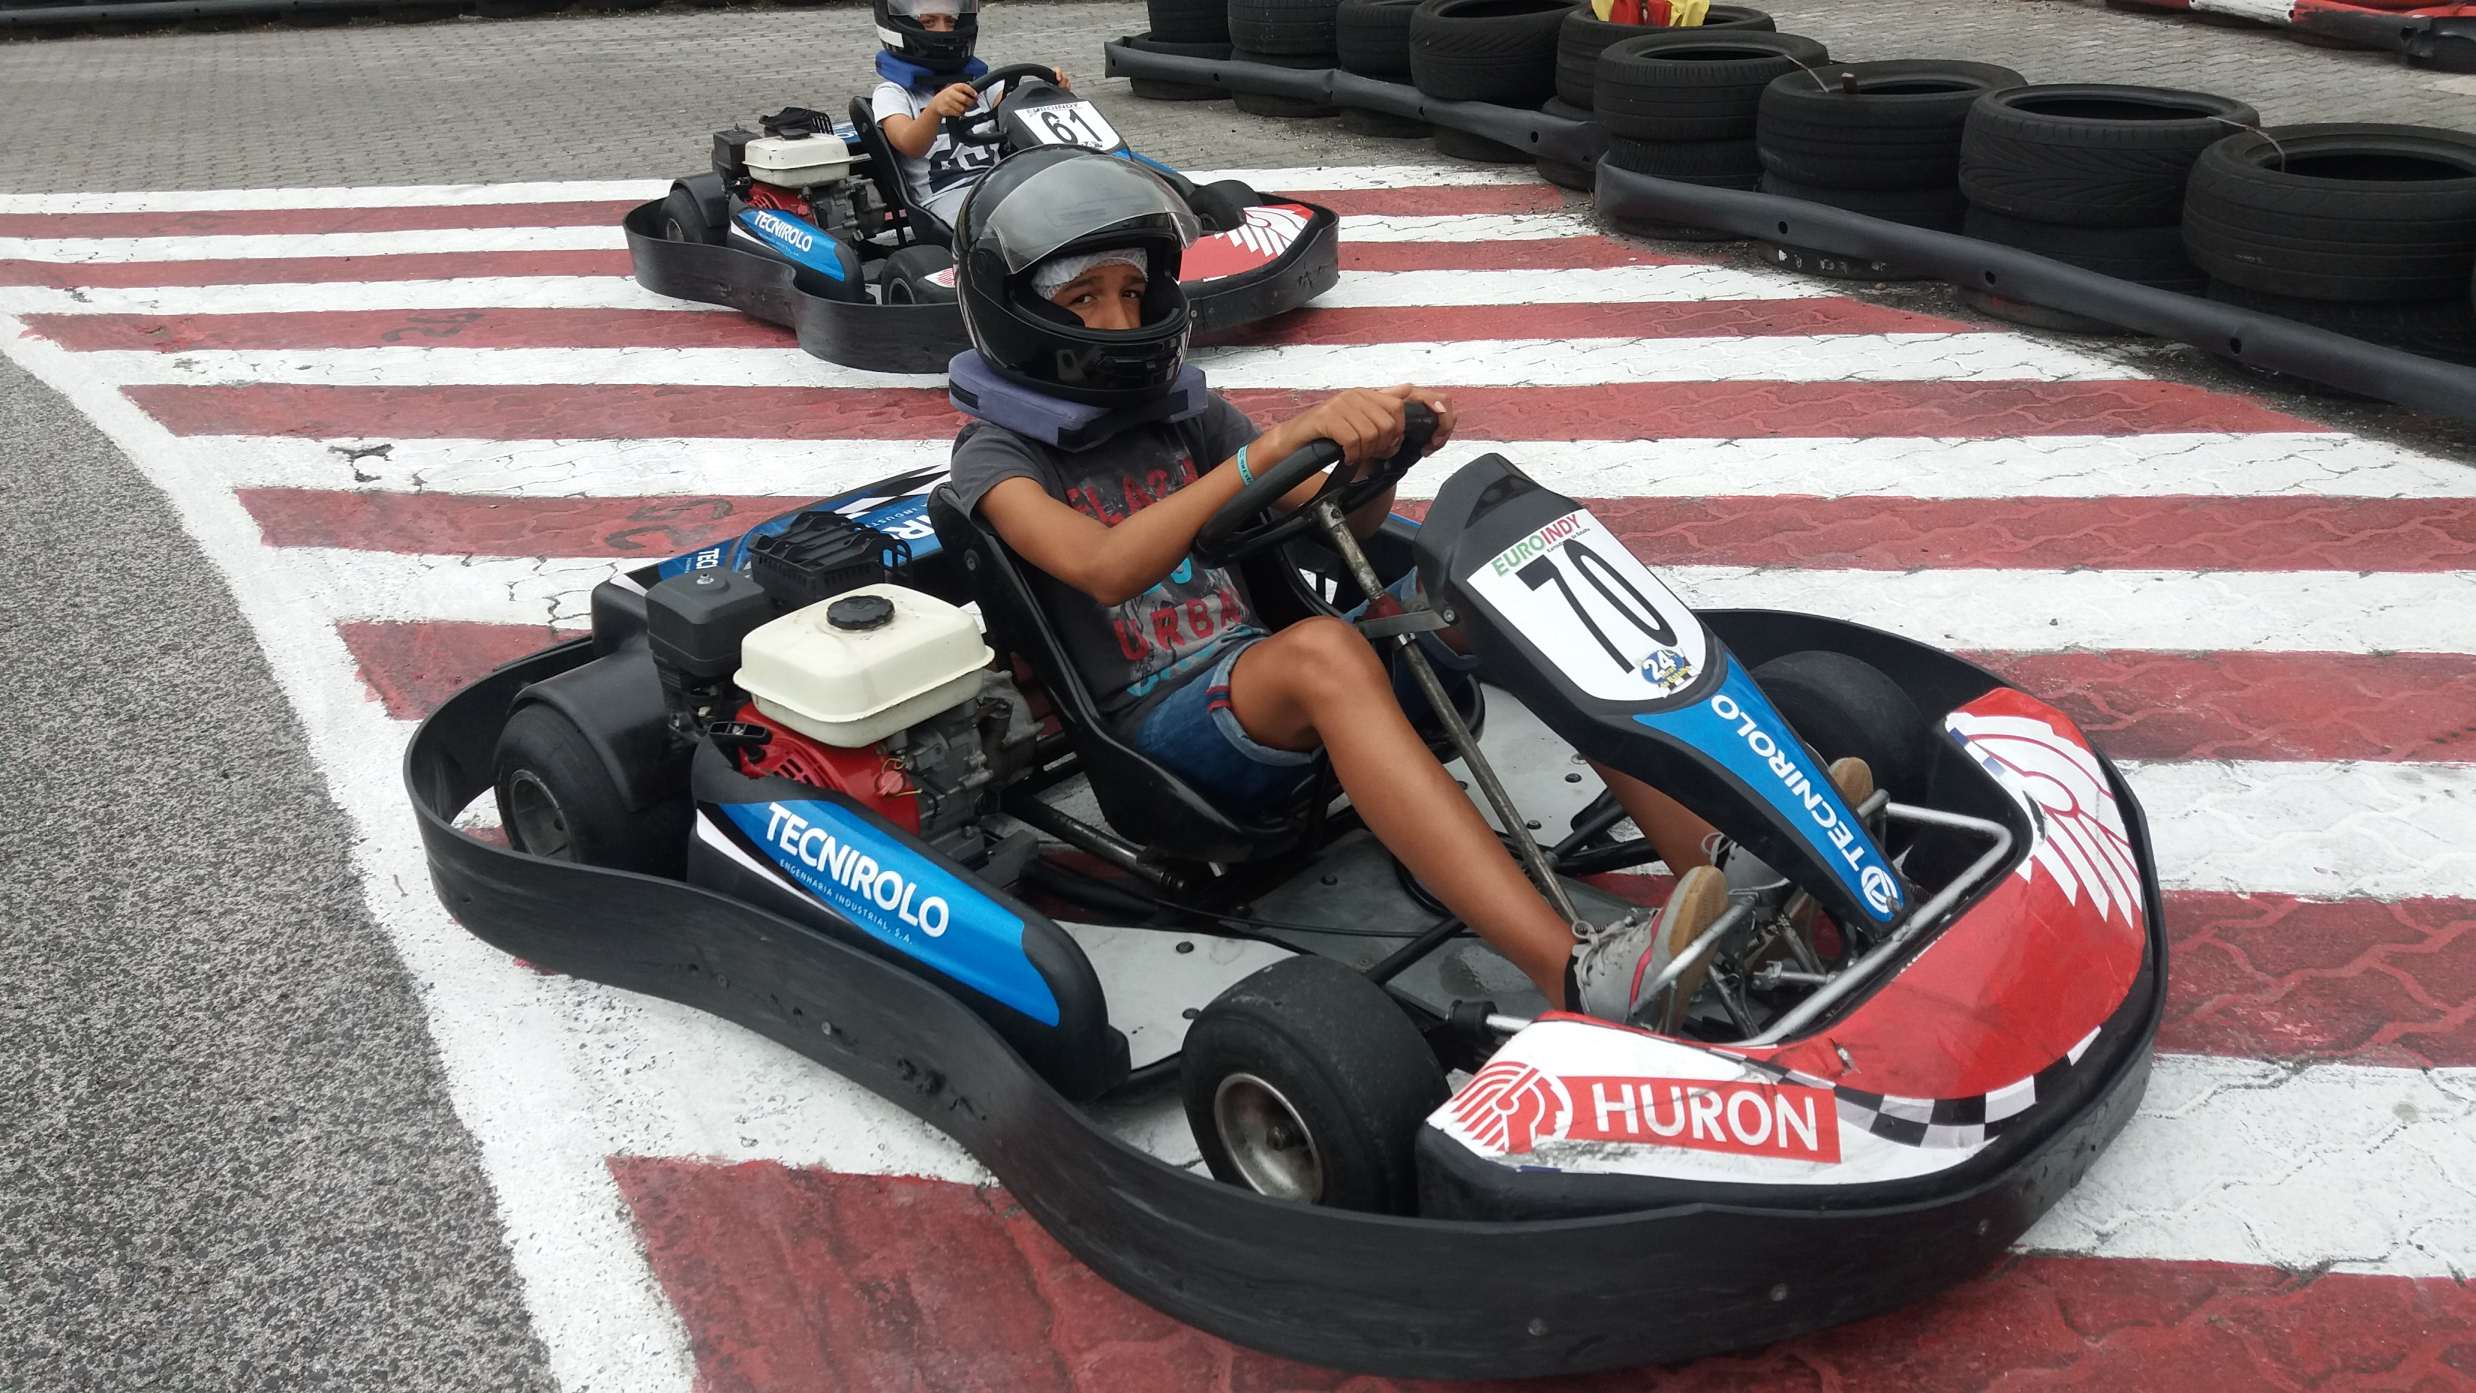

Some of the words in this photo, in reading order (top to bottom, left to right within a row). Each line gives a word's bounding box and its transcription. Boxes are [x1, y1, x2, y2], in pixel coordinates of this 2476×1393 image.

[1041, 108, 1103, 145] 61
[754, 210, 813, 252] TECNIROLO
[1491, 513, 1582, 577] EUROINDY
[1515, 538, 1679, 674] 70
[1643, 650, 1676, 683] 24
[1711, 694, 1865, 871] TECNIROLO
[766, 801, 950, 938] TECNIROLO
[779, 858, 834, 897] ENGENHARIA
[1592, 1082, 1819, 1152] HURON
